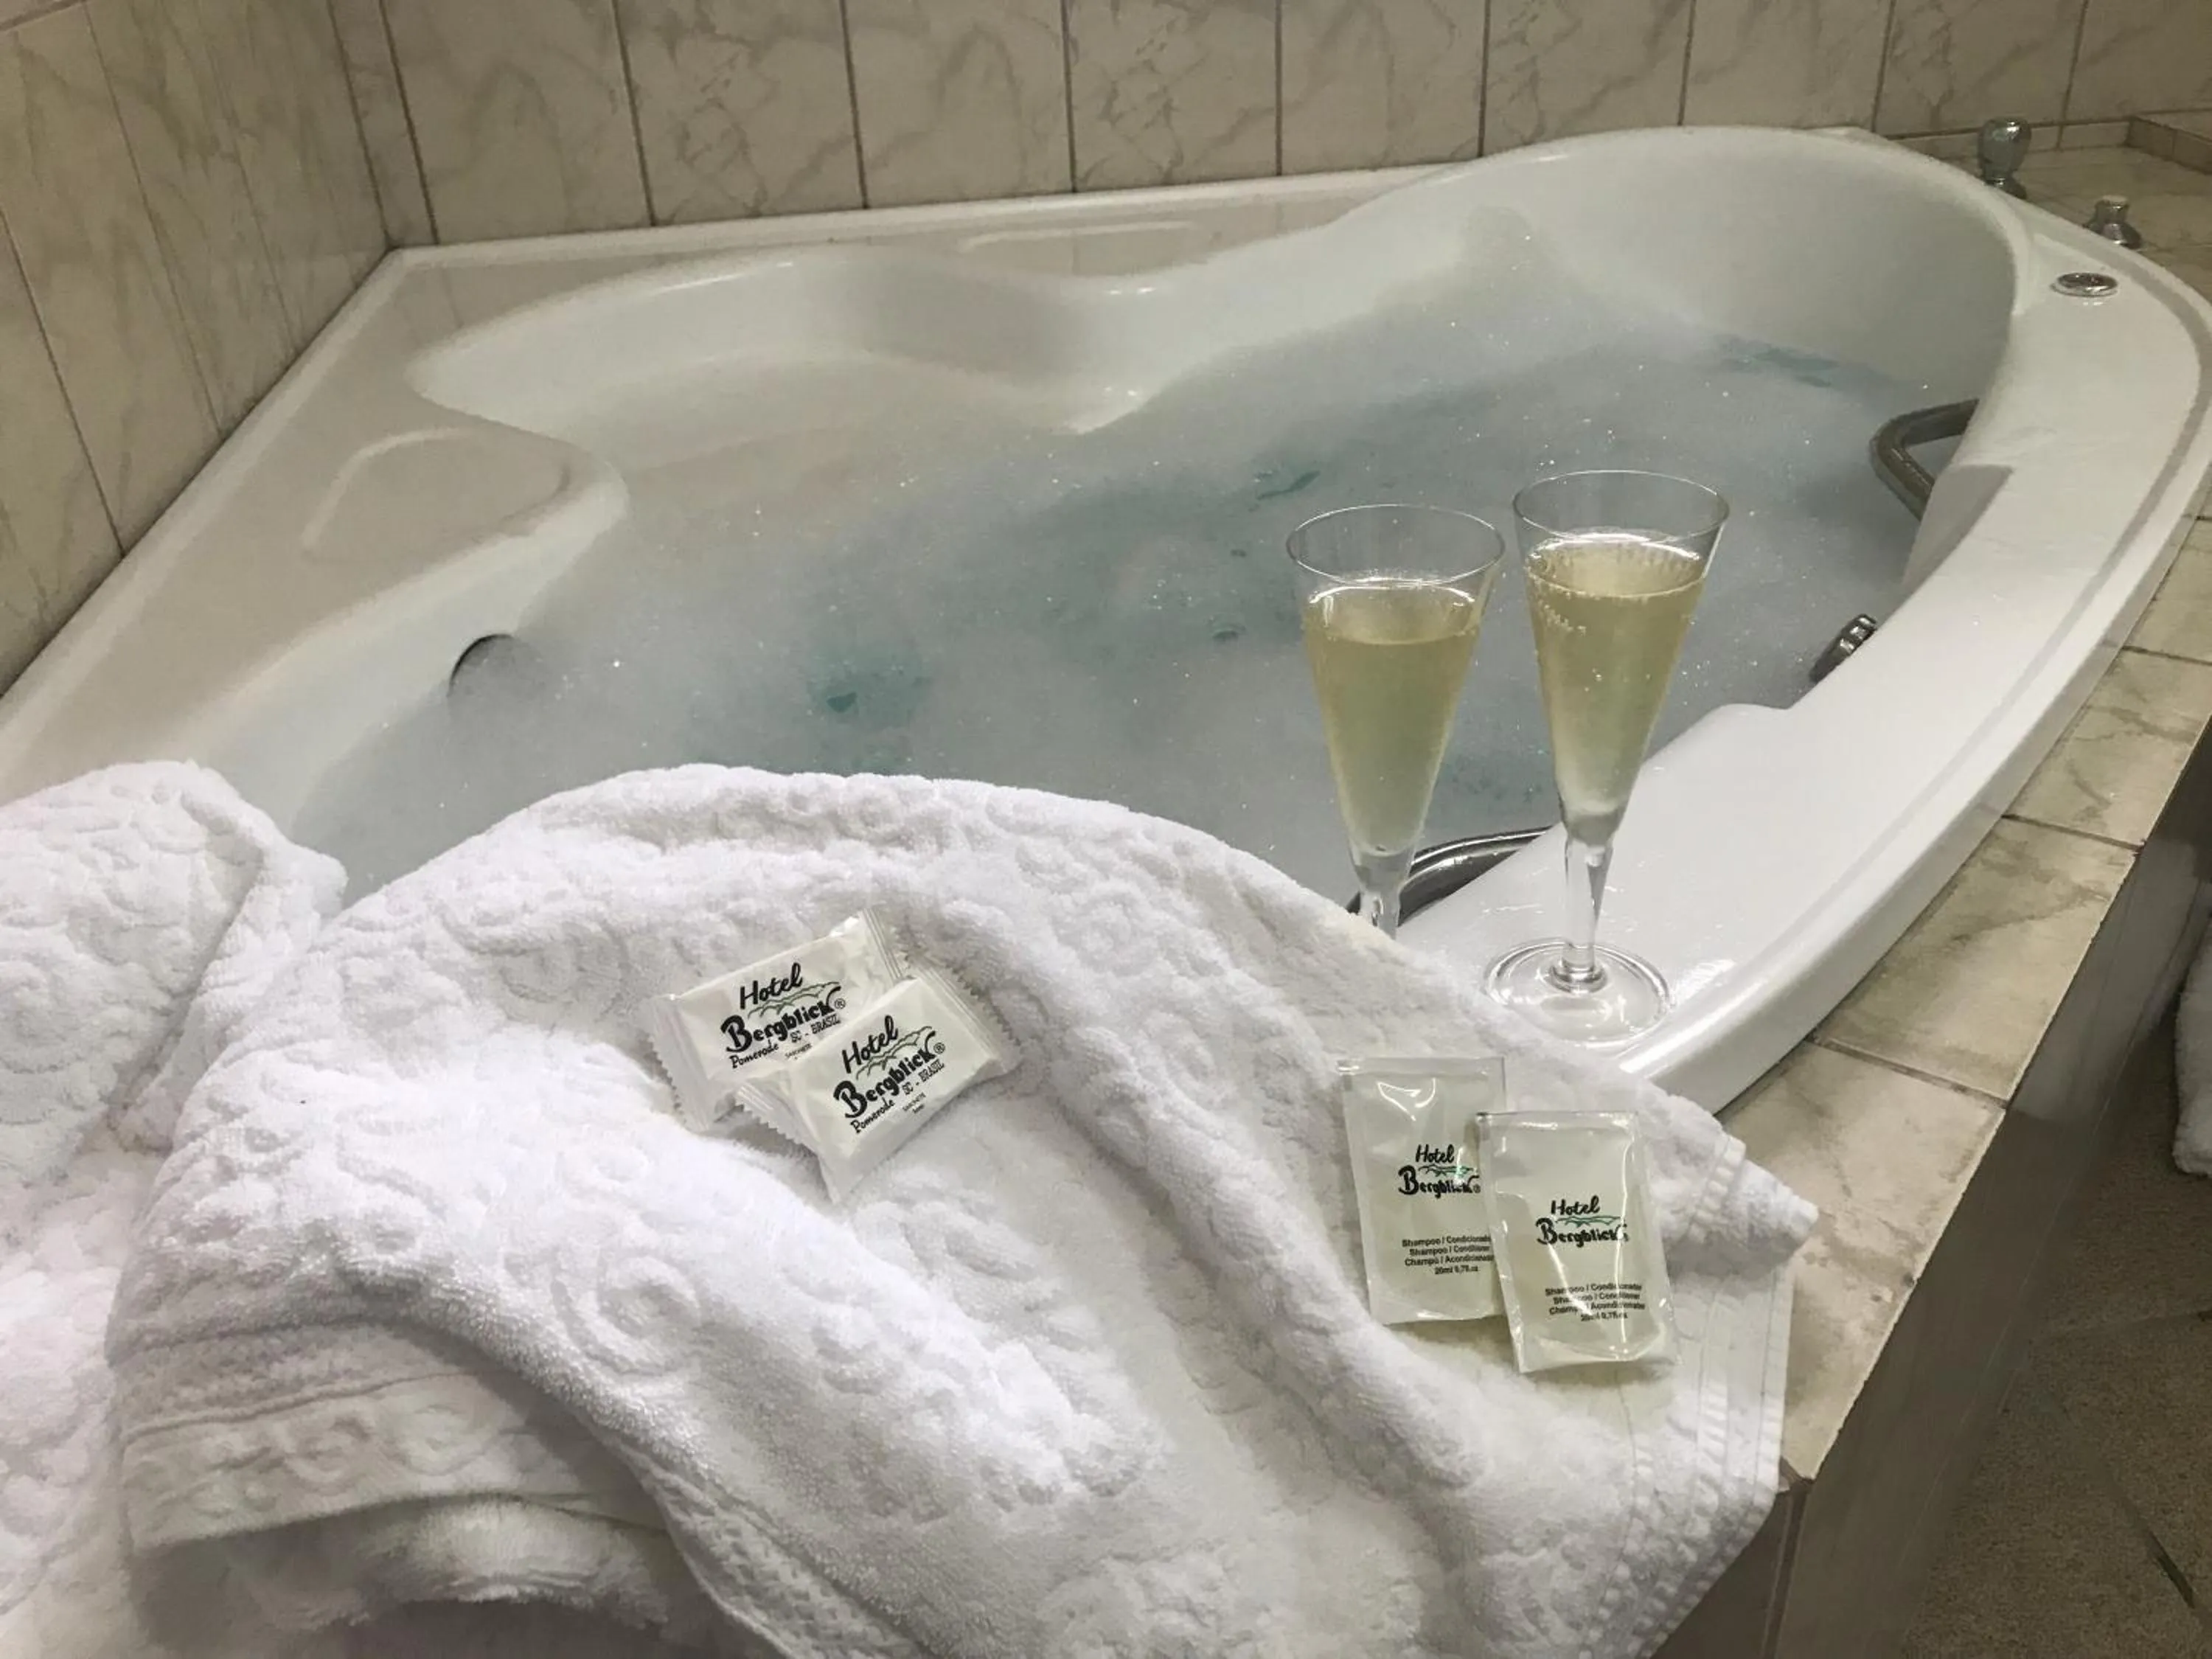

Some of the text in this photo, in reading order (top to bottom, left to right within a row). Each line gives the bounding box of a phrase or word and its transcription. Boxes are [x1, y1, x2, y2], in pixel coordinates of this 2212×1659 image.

[740, 962, 803, 1009] Hotel
[729, 1039, 779, 1068] Pomerode
[810, 1013, 841, 1034] BRASIL
[841, 1015, 899, 1074] Hotel
[849, 1096, 895, 1134] Pomerode
[918, 1059, 945, 1082] BRASIL
[1415, 1144, 1455, 1164] Hotel
[1551, 1194, 1601, 1216] Hotel
[1402, 1238, 1441, 1248] Shampoo
[1410, 1247, 1449, 1256] Shampoo
